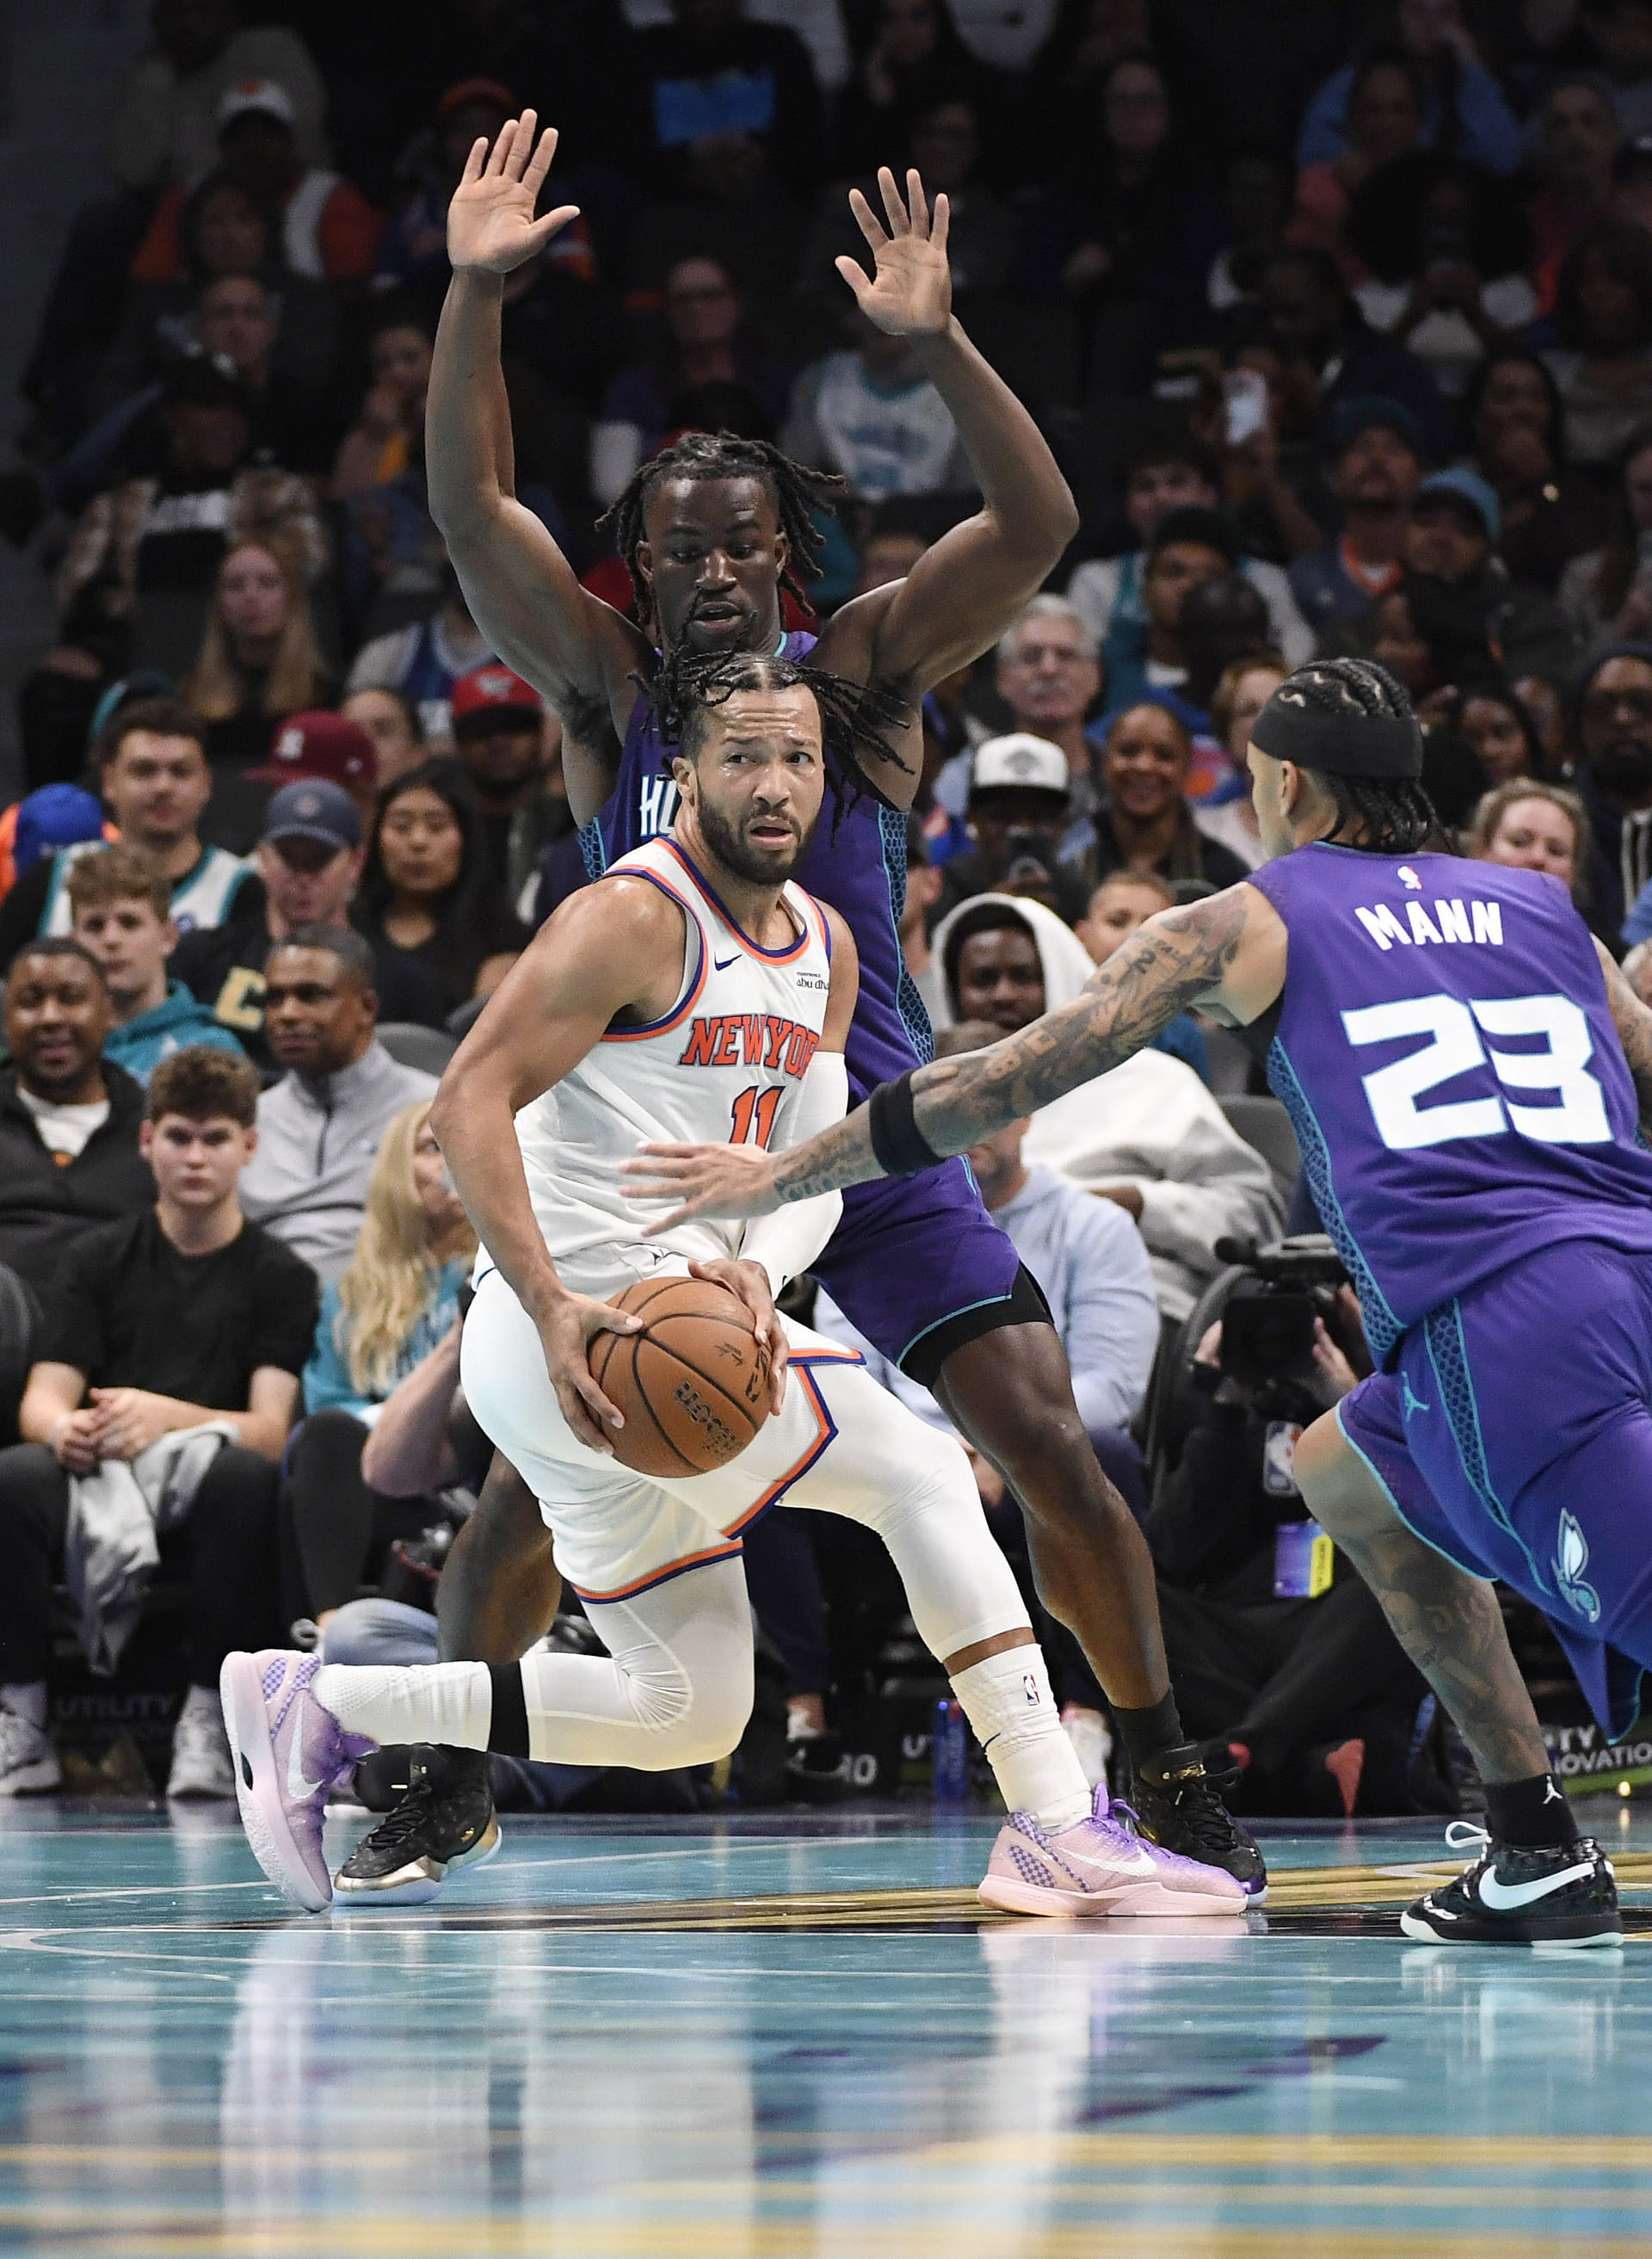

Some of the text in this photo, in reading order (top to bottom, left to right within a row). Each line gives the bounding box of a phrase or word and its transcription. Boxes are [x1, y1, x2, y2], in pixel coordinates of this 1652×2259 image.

[1354, 898, 1504, 950] MANN
[796, 978, 813, 989] abu
[679, 1014, 767, 1067] NEW
[1340, 992, 1615, 1150] 23
[729, 1085, 786, 1151] 11
